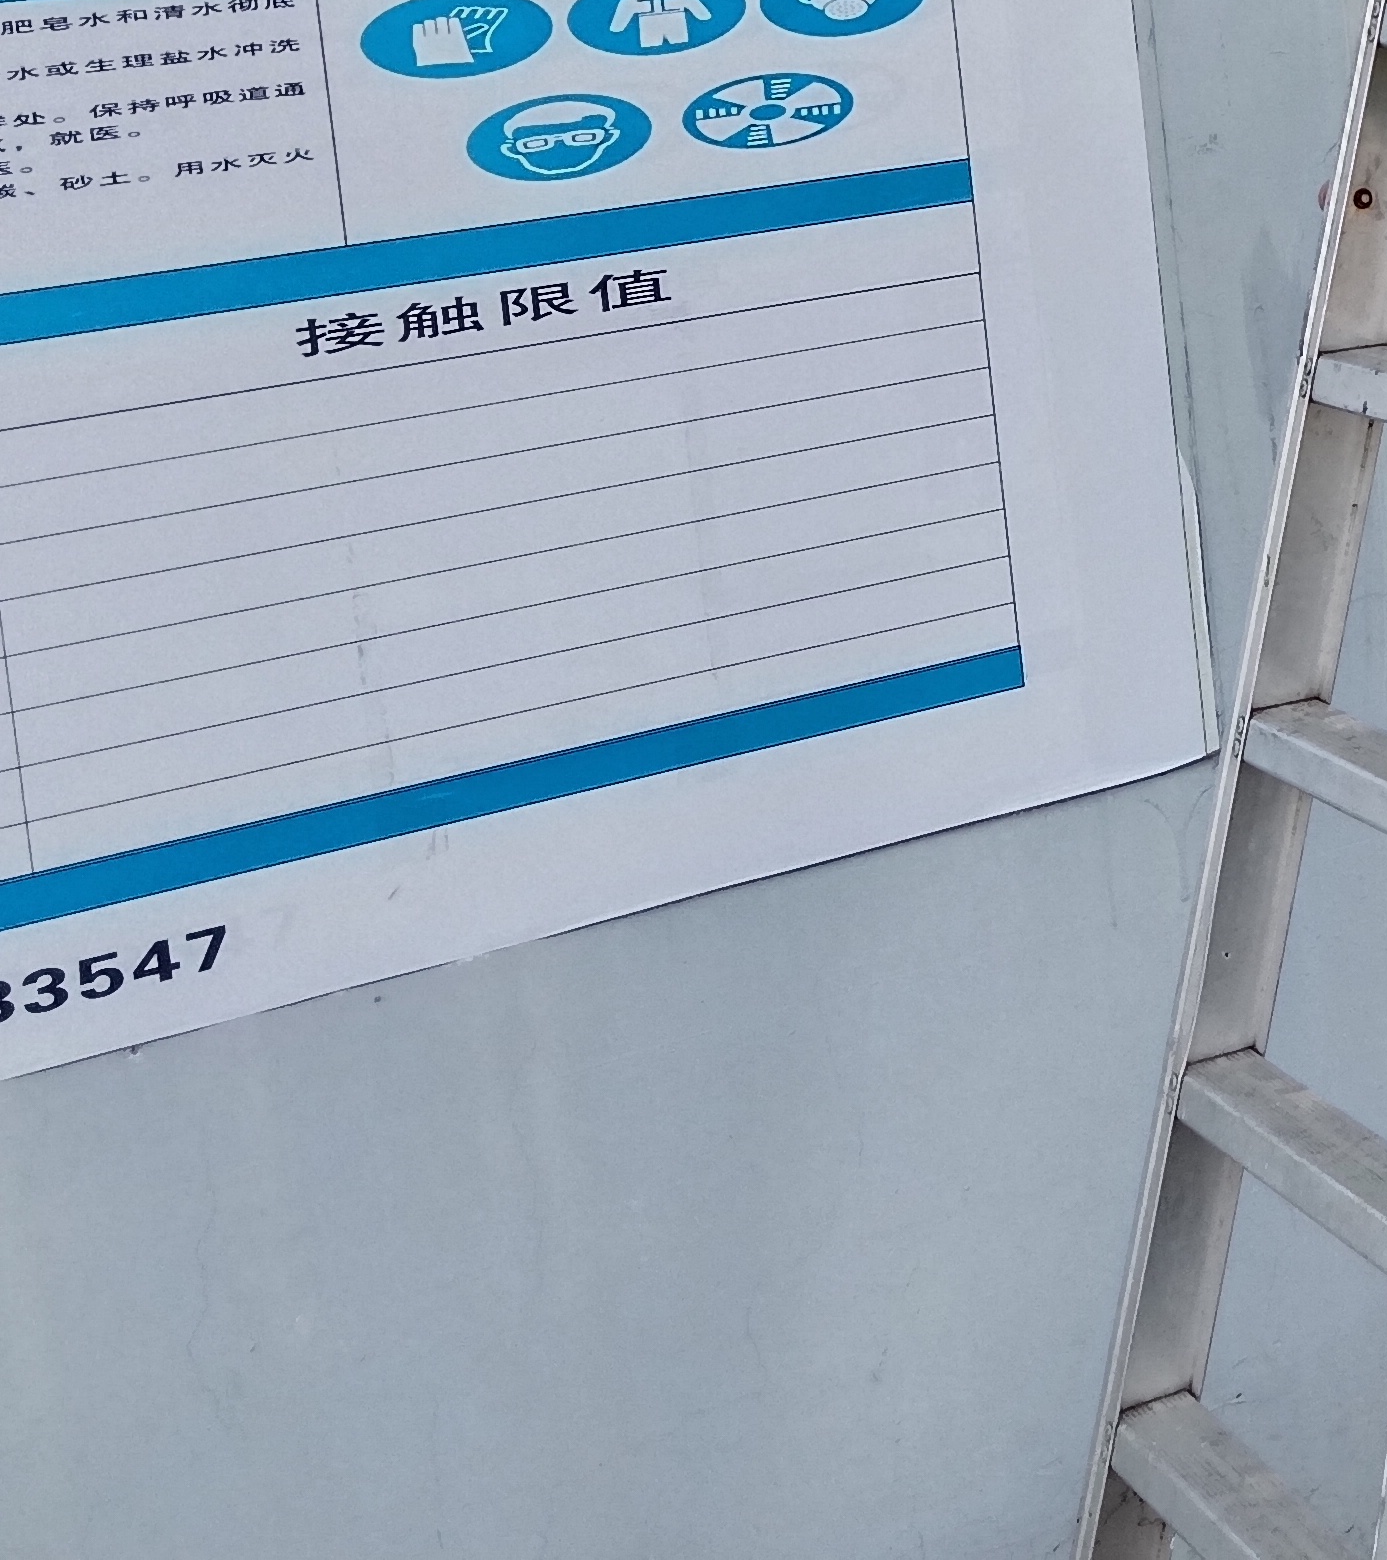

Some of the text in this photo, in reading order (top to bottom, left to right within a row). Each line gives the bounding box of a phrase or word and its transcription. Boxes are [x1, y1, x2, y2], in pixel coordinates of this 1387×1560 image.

[7, 38, 300, 81] 水或生理盐水冲洗
[0, 81, 306, 127] 处。保持呼吸道通
[0, 125, 141, 152] ，就医。
[296, 269, 671, 357] 接触限值
